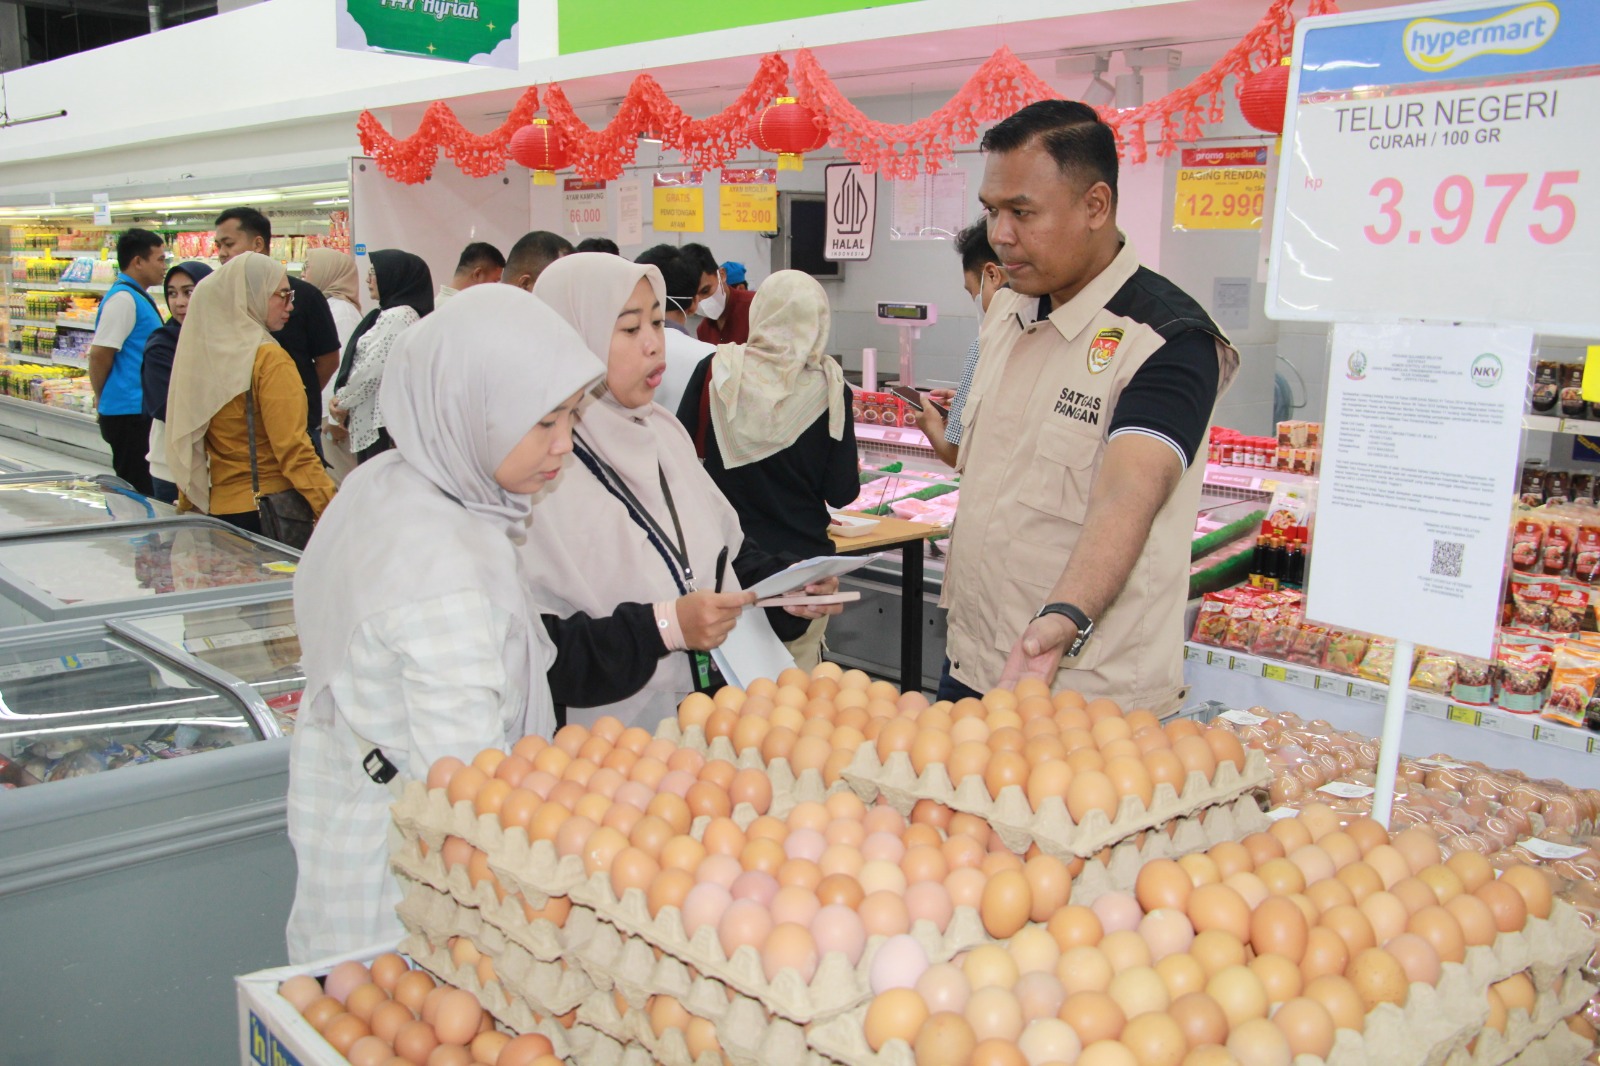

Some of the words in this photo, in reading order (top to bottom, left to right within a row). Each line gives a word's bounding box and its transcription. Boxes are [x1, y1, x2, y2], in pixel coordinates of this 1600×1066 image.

[1411, 16, 1546, 54] hypermart
[1335, 102, 1424, 132] TELUR
[1434, 90, 1558, 126] NEGERI
[1369, 133, 1427, 150] CURAH
[1442, 131, 1468, 146] 100
[1475, 129, 1500, 144] GR
[1195, 152, 1224, 161] promo
[1225, 150, 1257, 159] spesial
[1181, 170, 1221, 181] DAGING
[1304, 175, 1323, 190] Rp
[665, 193, 690, 203] GRATIS
[1187, 193, 1264, 217] 12.990
[1363, 170, 1580, 245] 3.975
[570, 208, 601, 223] 66.000
[735, 209, 771, 223] 32.900
[832, 239, 865, 249] HALAL
[1473, 366, 1499, 378] NKV
[1060, 387, 1101, 411] SATGAS
[1054, 401, 1098, 425] PANGAN
